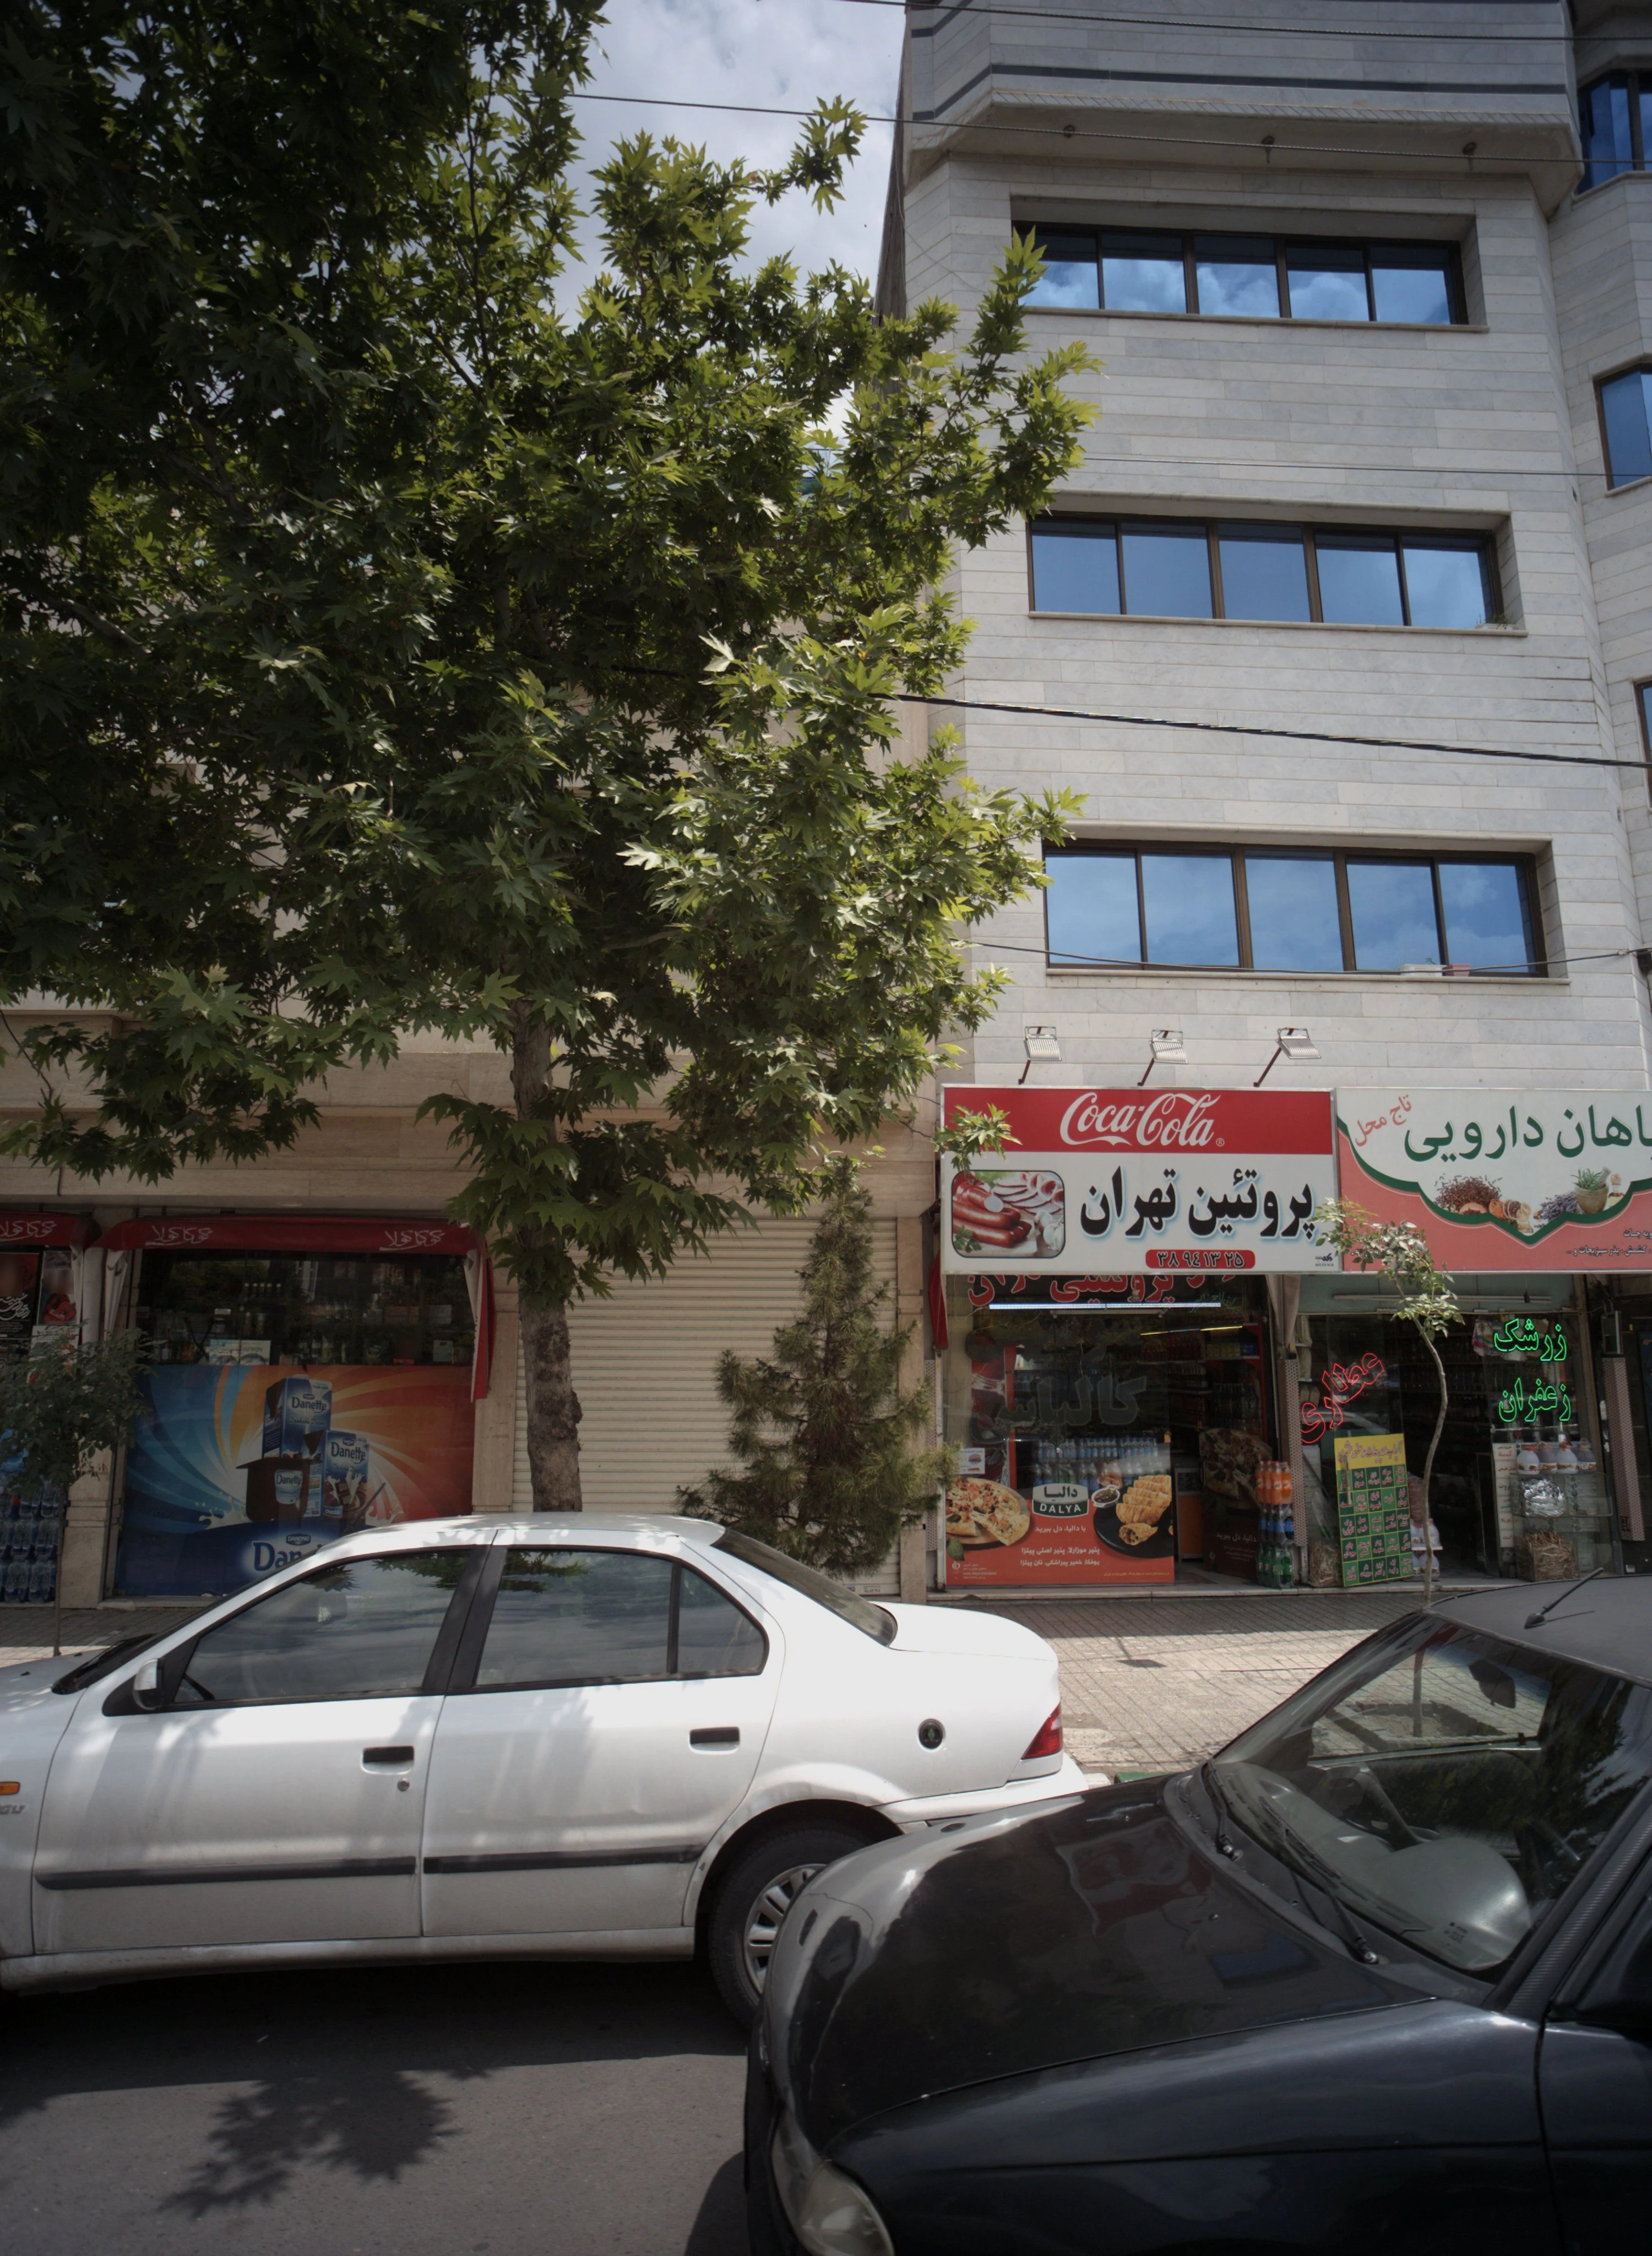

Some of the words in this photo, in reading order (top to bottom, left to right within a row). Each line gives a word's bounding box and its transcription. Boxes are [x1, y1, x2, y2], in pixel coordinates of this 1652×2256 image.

[1059, 1092, 1221, 1146] Coca-Cola
[1390, 1094, 1411, 1125] تاج
[1355, 1116, 1387, 1147] محل
[1405, 1105, 1544, 1163] دارویی
[1080, 1165, 1177, 1236] تهران
[1188, 1168, 1316, 1239] پروتئین
[1493, 1318, 1568, 1362] زرشک
[292, 1396, 327, 1413] Danette
[1301, 1352, 1384, 1444] عطاری
[1498, 1377, 1572, 1423] زعفران
[330, 1441, 366, 1463] Danette
[276, 1474, 302, 1487] Danette
[1044, 1485, 1078, 1501] دالیا
[1040, 1503, 1082, 1514] DALYA
[1021, 1547, 1035, 1555] پیتزا
[1053, 1547, 1065, 1555] پنیر
